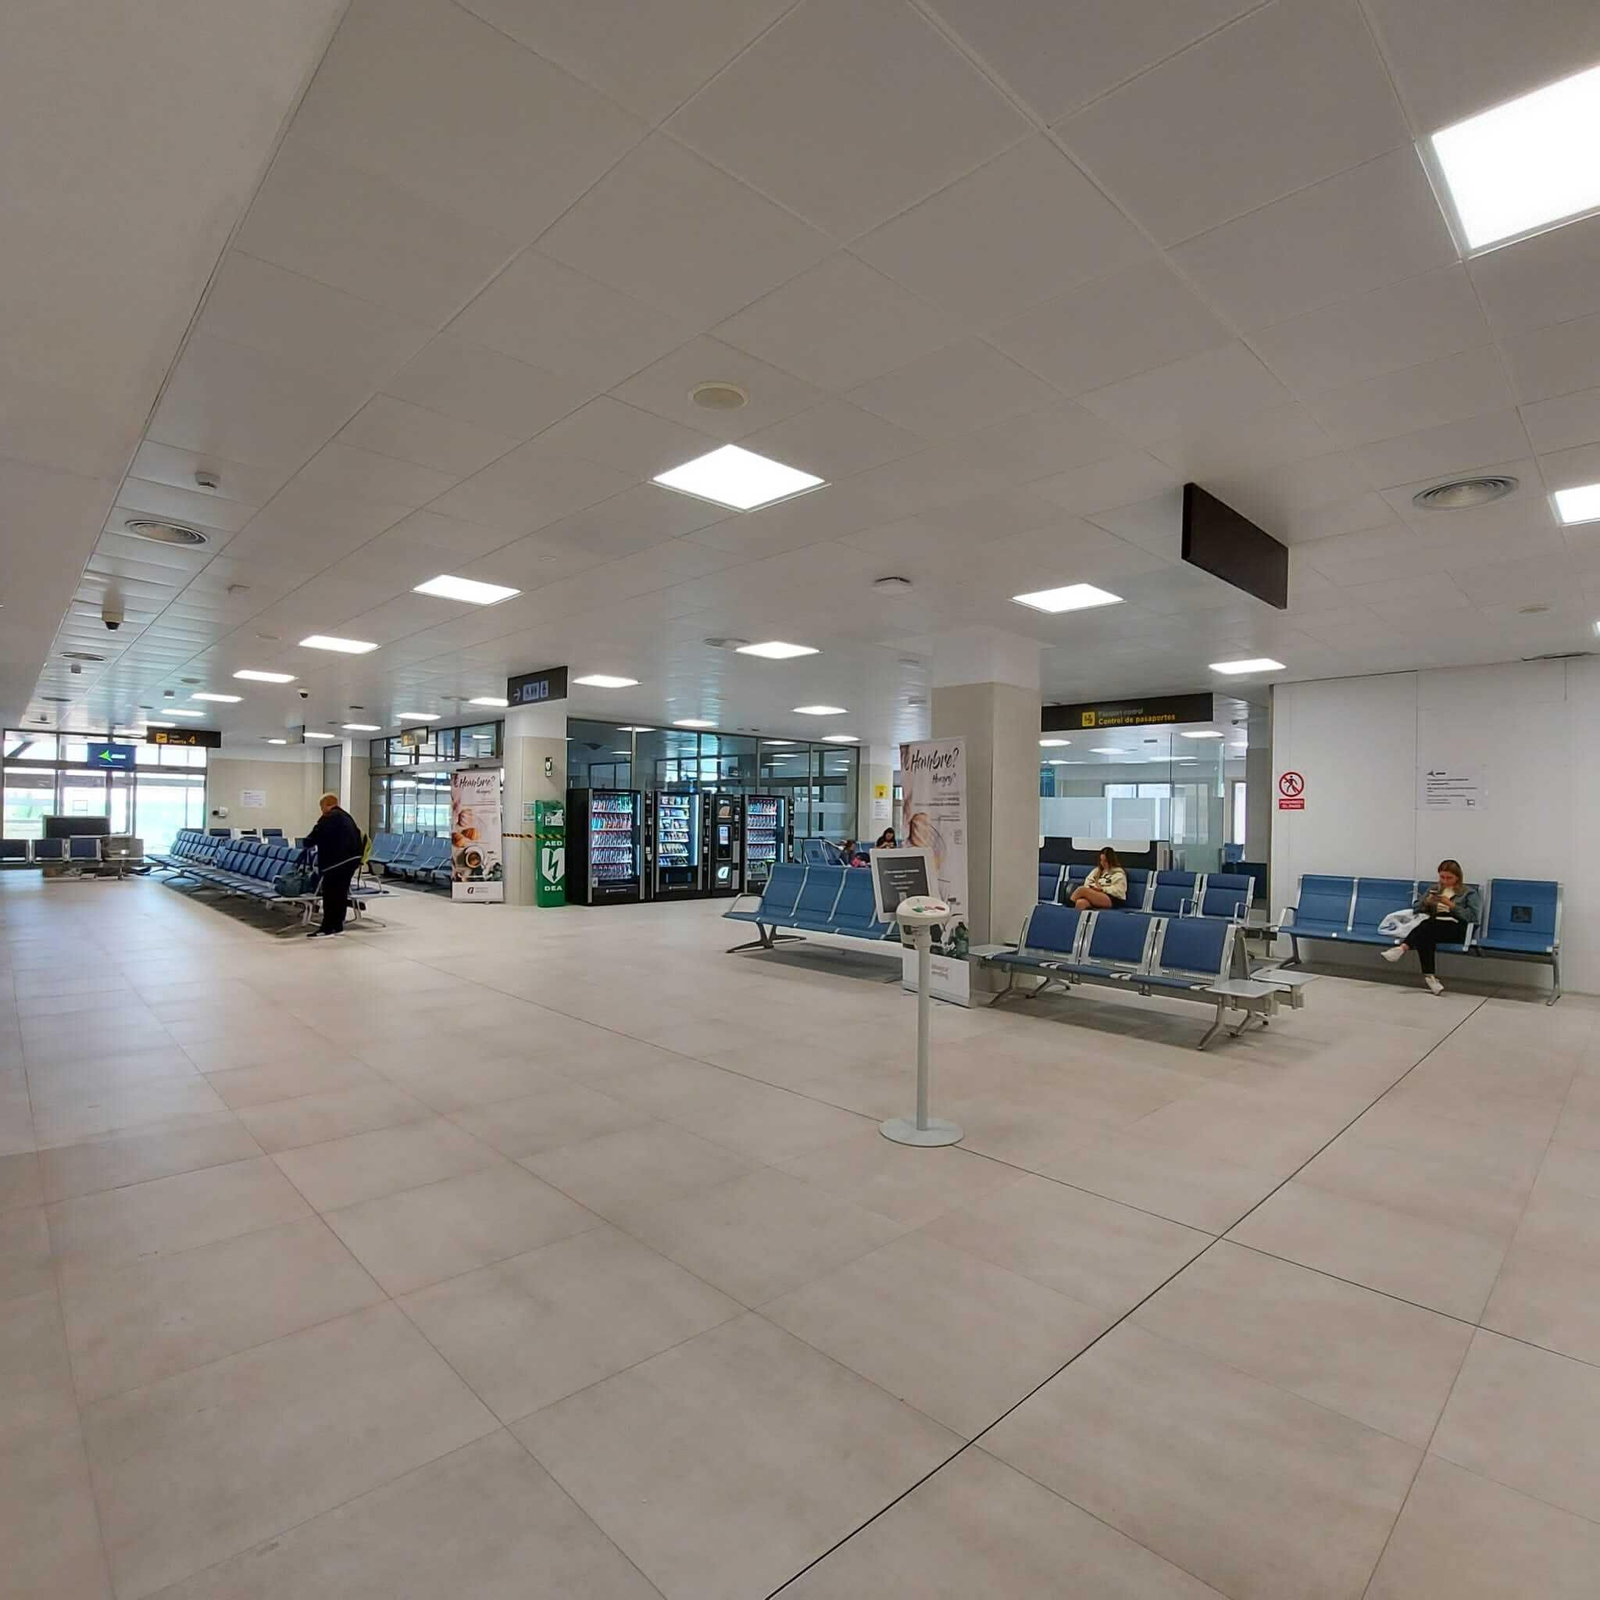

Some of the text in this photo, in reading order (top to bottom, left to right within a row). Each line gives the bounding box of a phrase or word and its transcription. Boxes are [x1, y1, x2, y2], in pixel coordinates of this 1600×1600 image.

[1098, 715, 1123, 725] Control
[1136, 713, 1176, 724] pasaportes
[189, 736, 196, 744] 4
